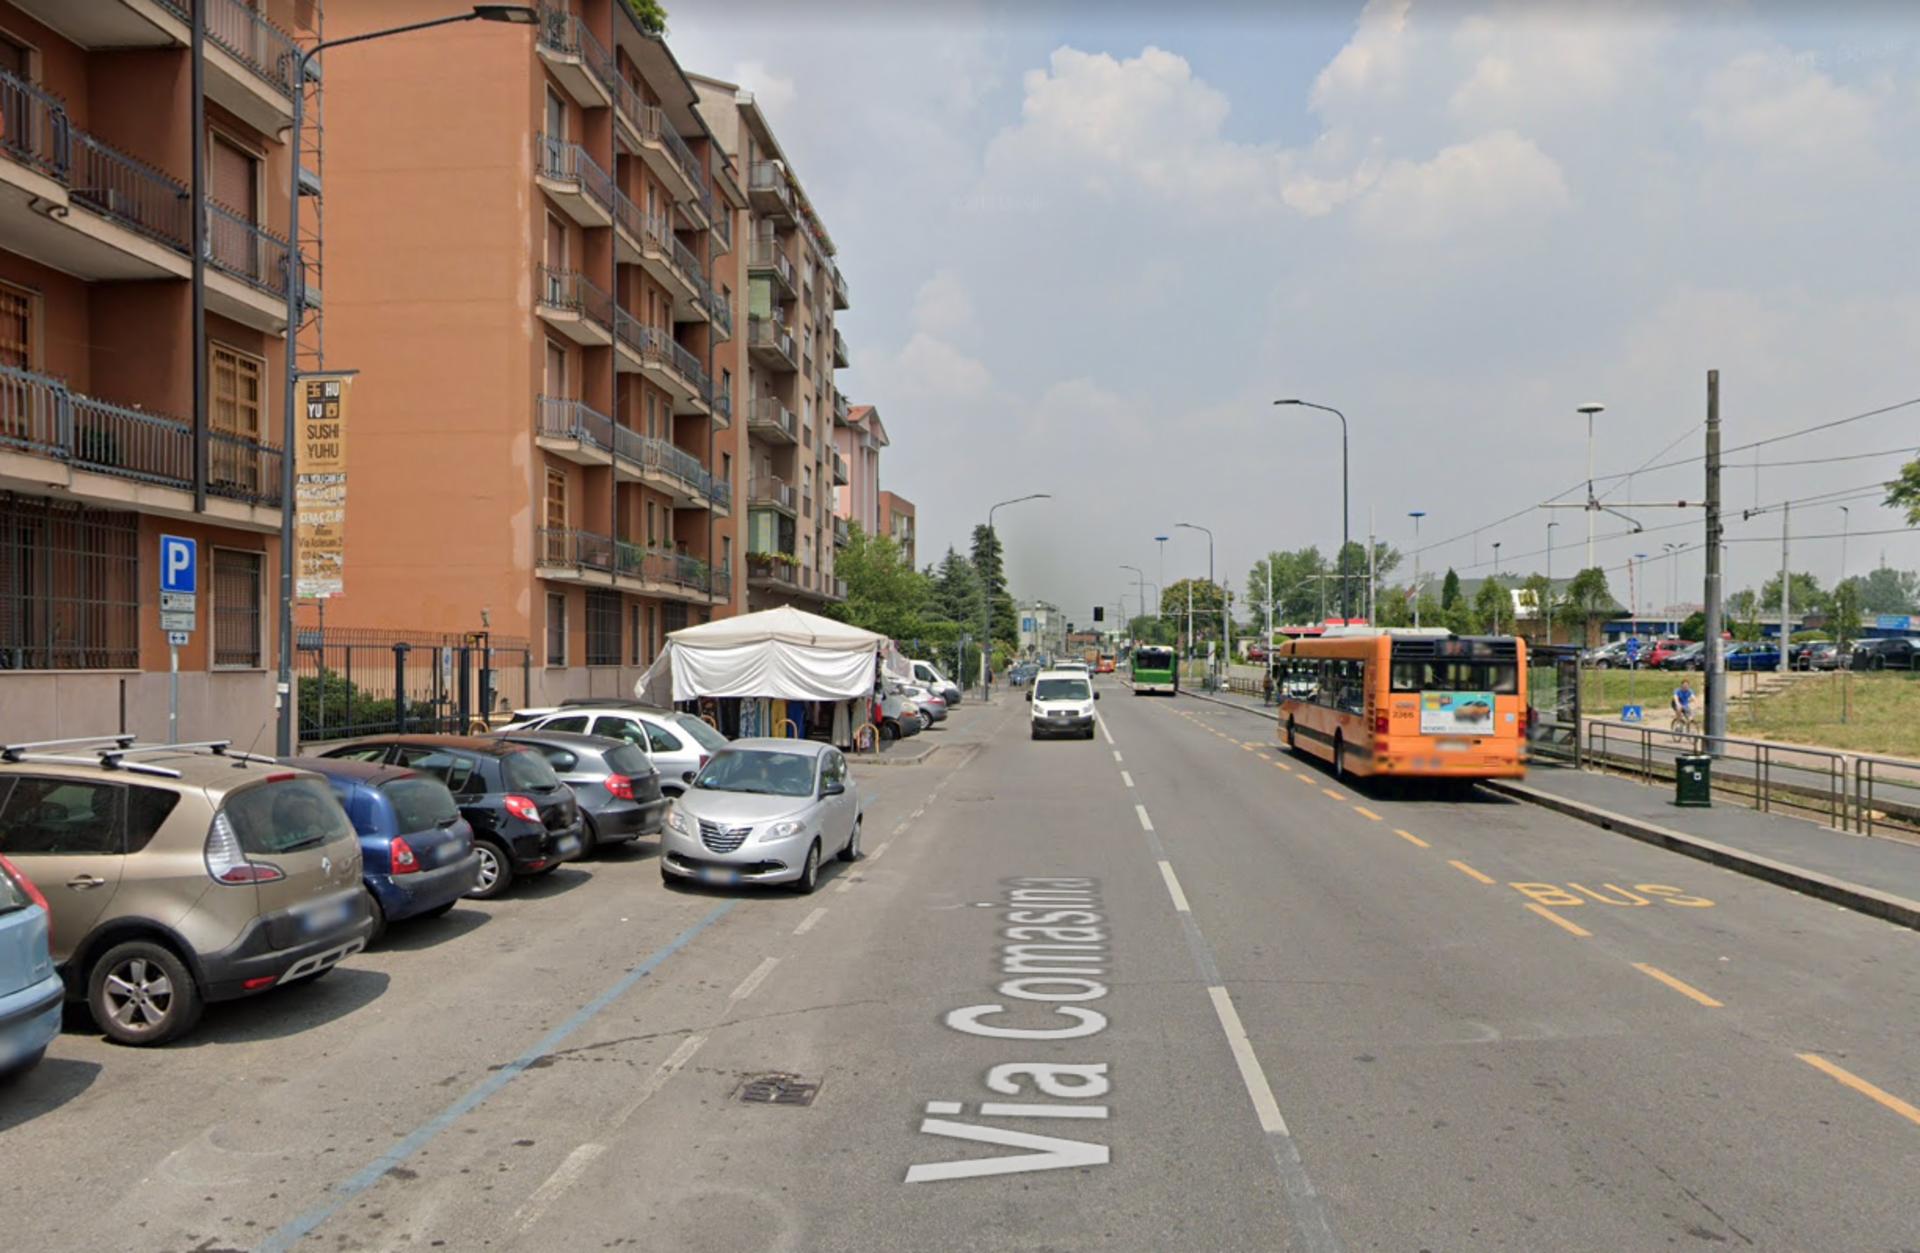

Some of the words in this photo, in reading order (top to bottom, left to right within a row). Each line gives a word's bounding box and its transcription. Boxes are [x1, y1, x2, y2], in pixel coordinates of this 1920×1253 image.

[325, 382, 340, 397] HU
[308, 402, 323, 418] YU
[307, 424, 340, 440] SUSHI
[306, 443, 340, 459] YUHU
[168, 541, 190, 586] P
[1508, 881, 1716, 908] BUS
